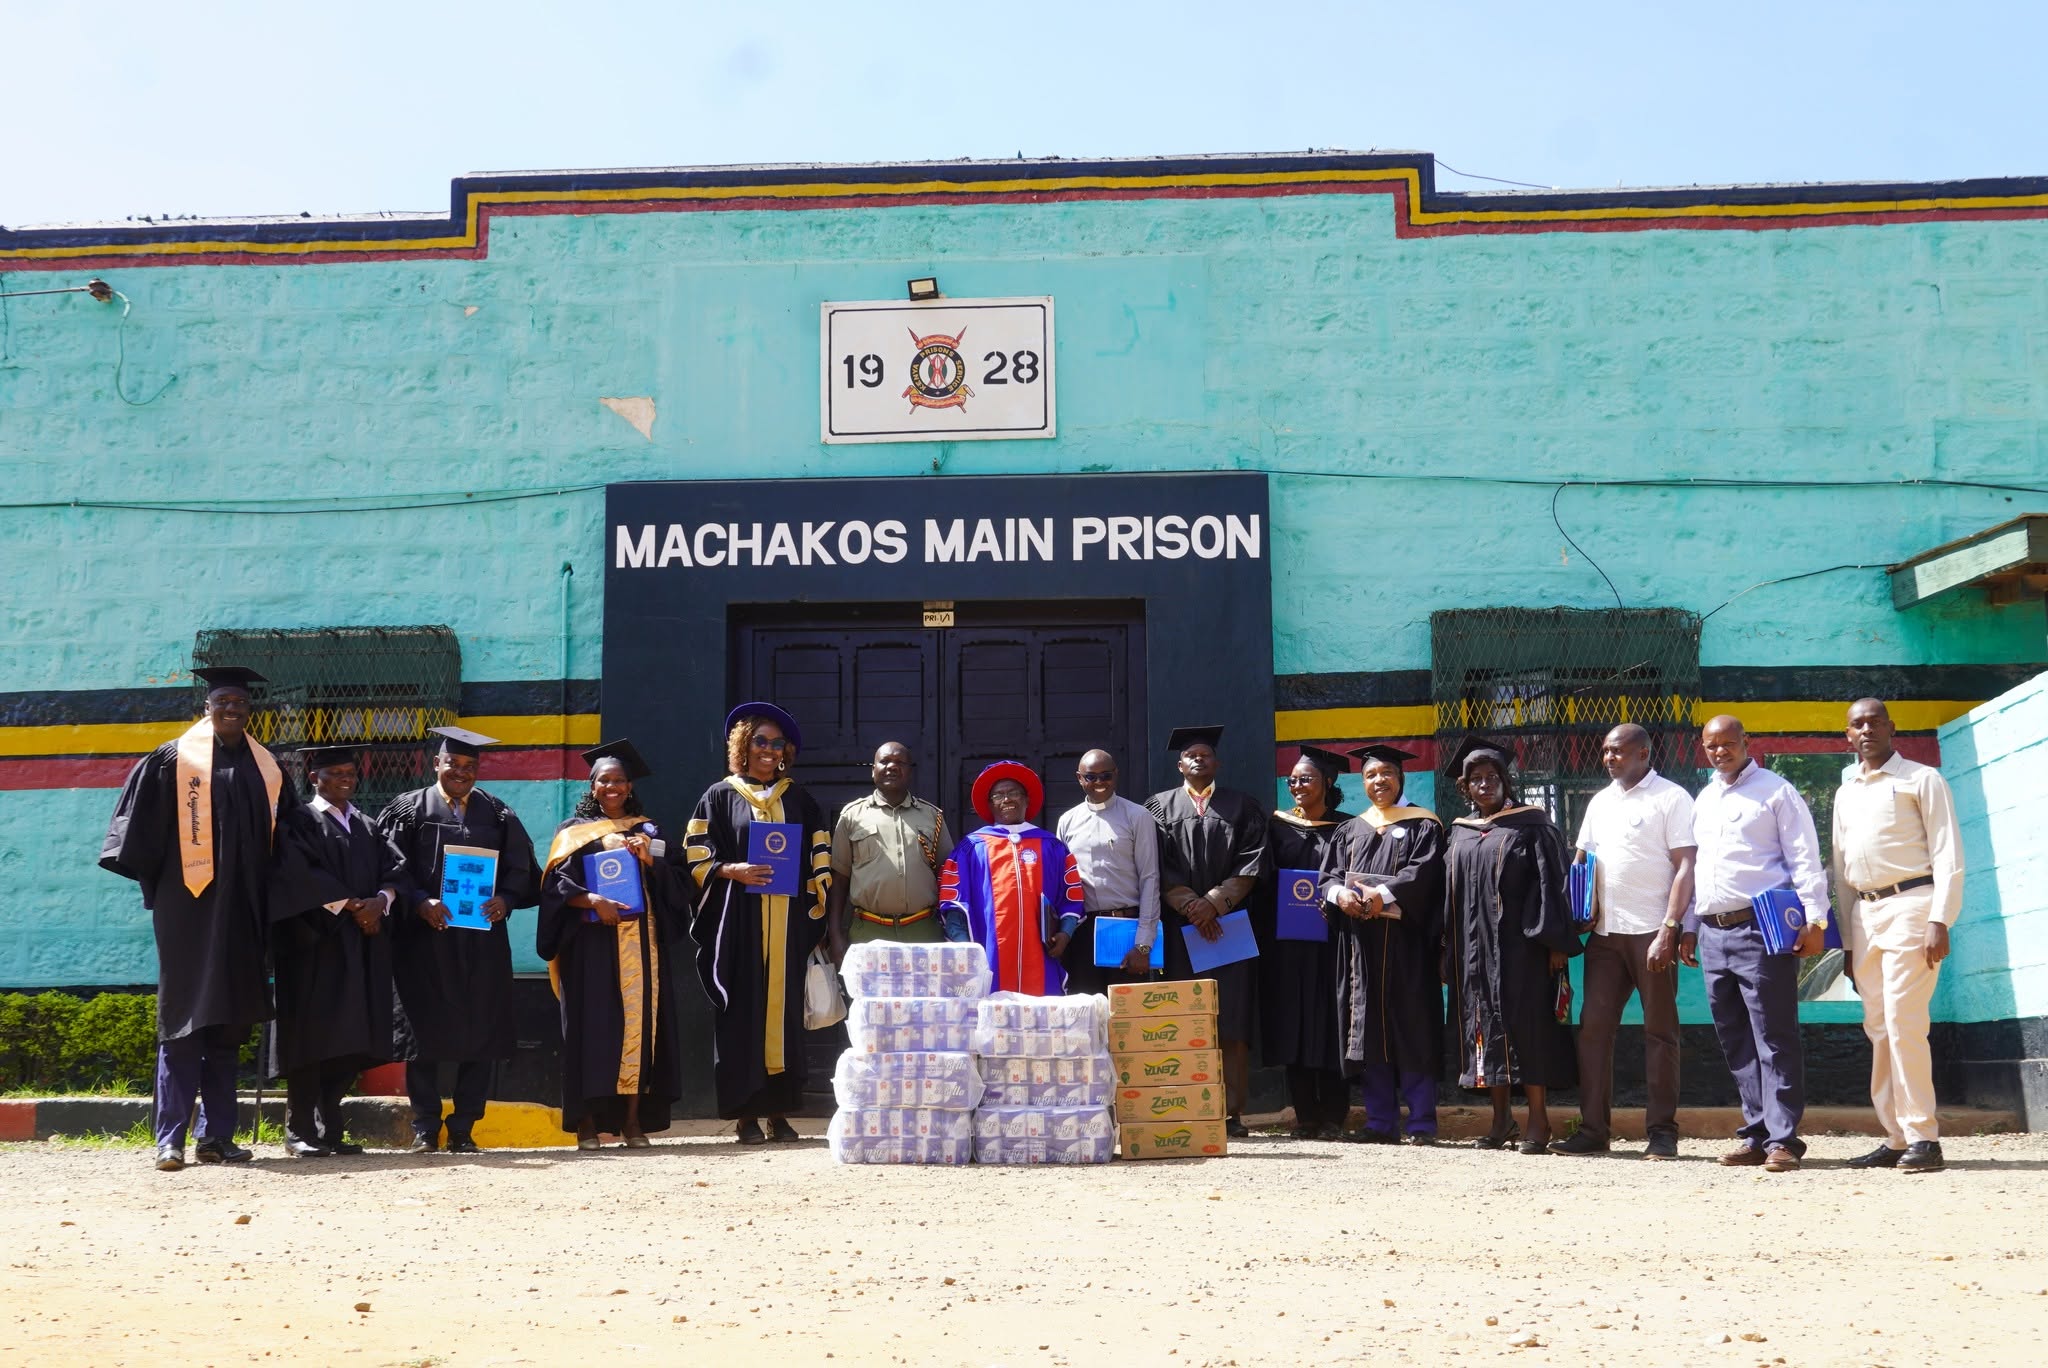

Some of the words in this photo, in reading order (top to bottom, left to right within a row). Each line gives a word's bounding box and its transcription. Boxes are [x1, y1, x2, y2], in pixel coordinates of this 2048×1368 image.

[843, 354, 884, 388] 19
[911, 363, 927, 391] KENYA
[920, 346, 955, 358] PRISONS
[947, 360, 963, 392] SERVICE
[983, 350, 1039, 385] 28
[616, 519, 908, 568] MACHAKOS
[924, 517, 1053, 562] MAIN
[1073, 514, 1260, 560] PRISON
[1143, 991, 1179, 1004] ZENTA
[1142, 1031, 1178, 1042] ZENTA
[1144, 1063, 1181, 1076] ZENTA
[1151, 1096, 1188, 1109] ZENTA
[1154, 1135, 1192, 1148] ZENTA
